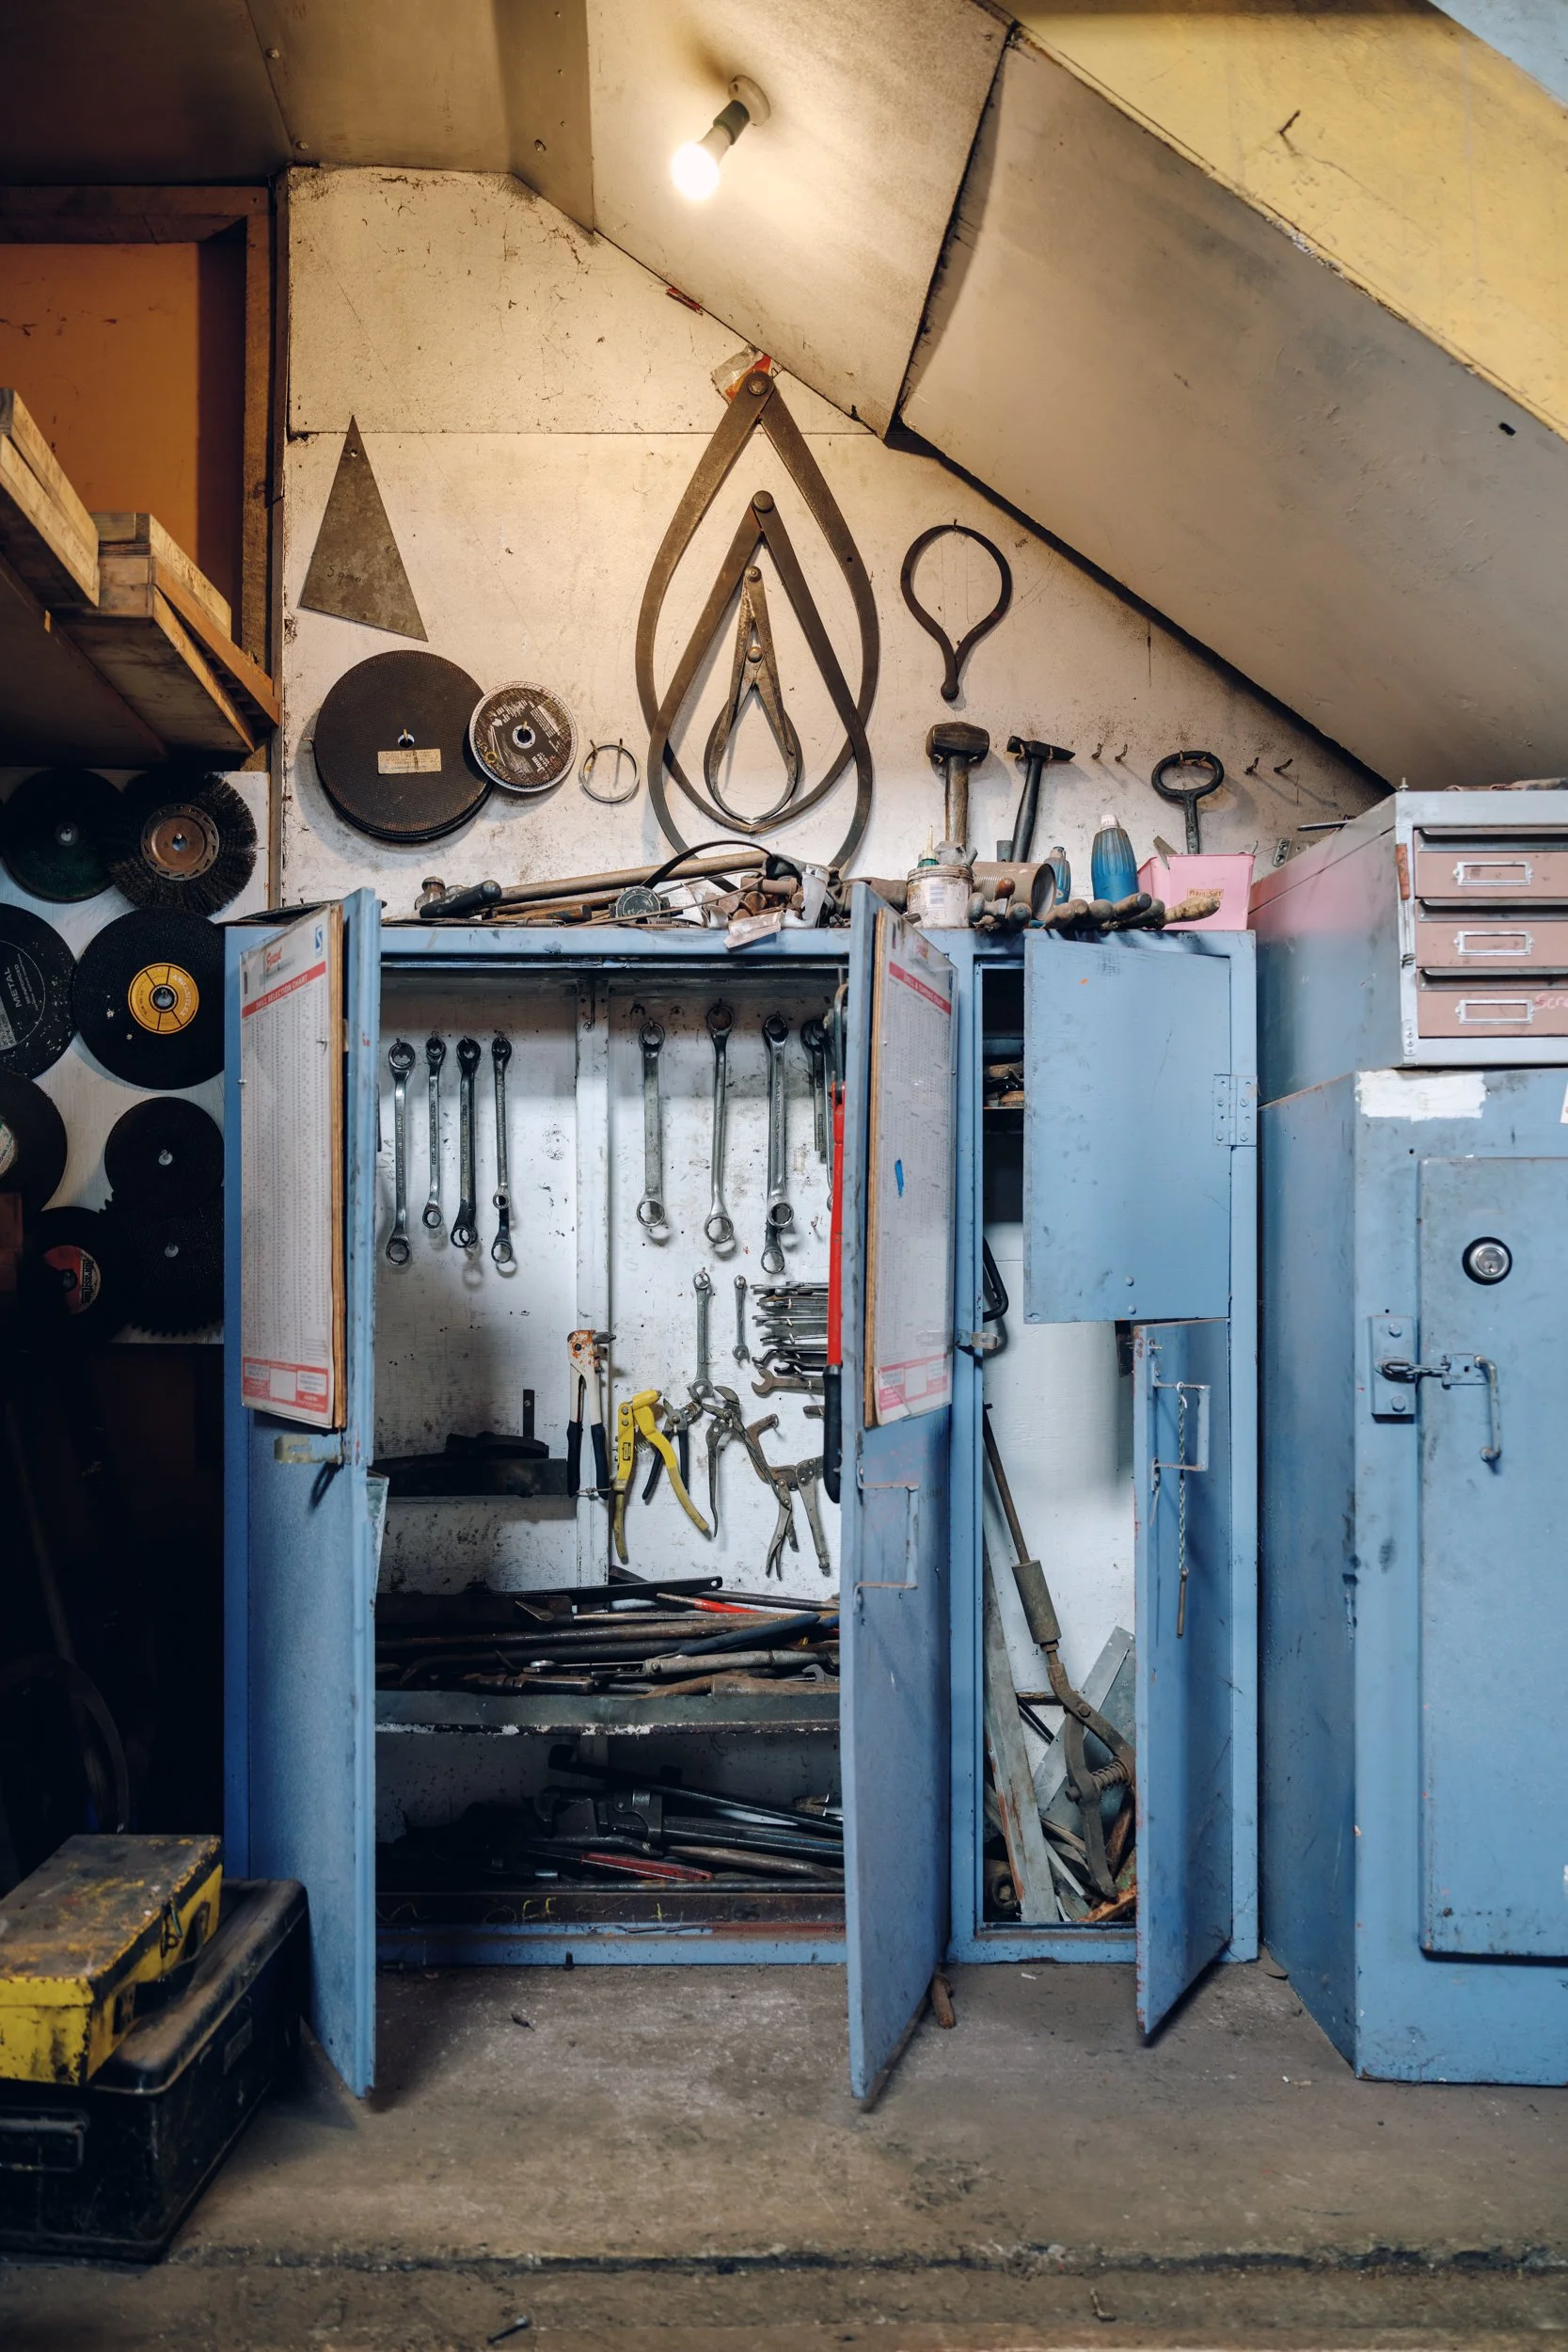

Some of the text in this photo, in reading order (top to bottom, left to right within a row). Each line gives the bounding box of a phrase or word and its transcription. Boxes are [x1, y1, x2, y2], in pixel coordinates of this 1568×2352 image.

[4, 966, 23, 1009] METAL
[14, 963, 31, 1005] REINFORCED
[267, 984, 293, 1003] SELECTION
[292, 974, 309, 991] CHART
